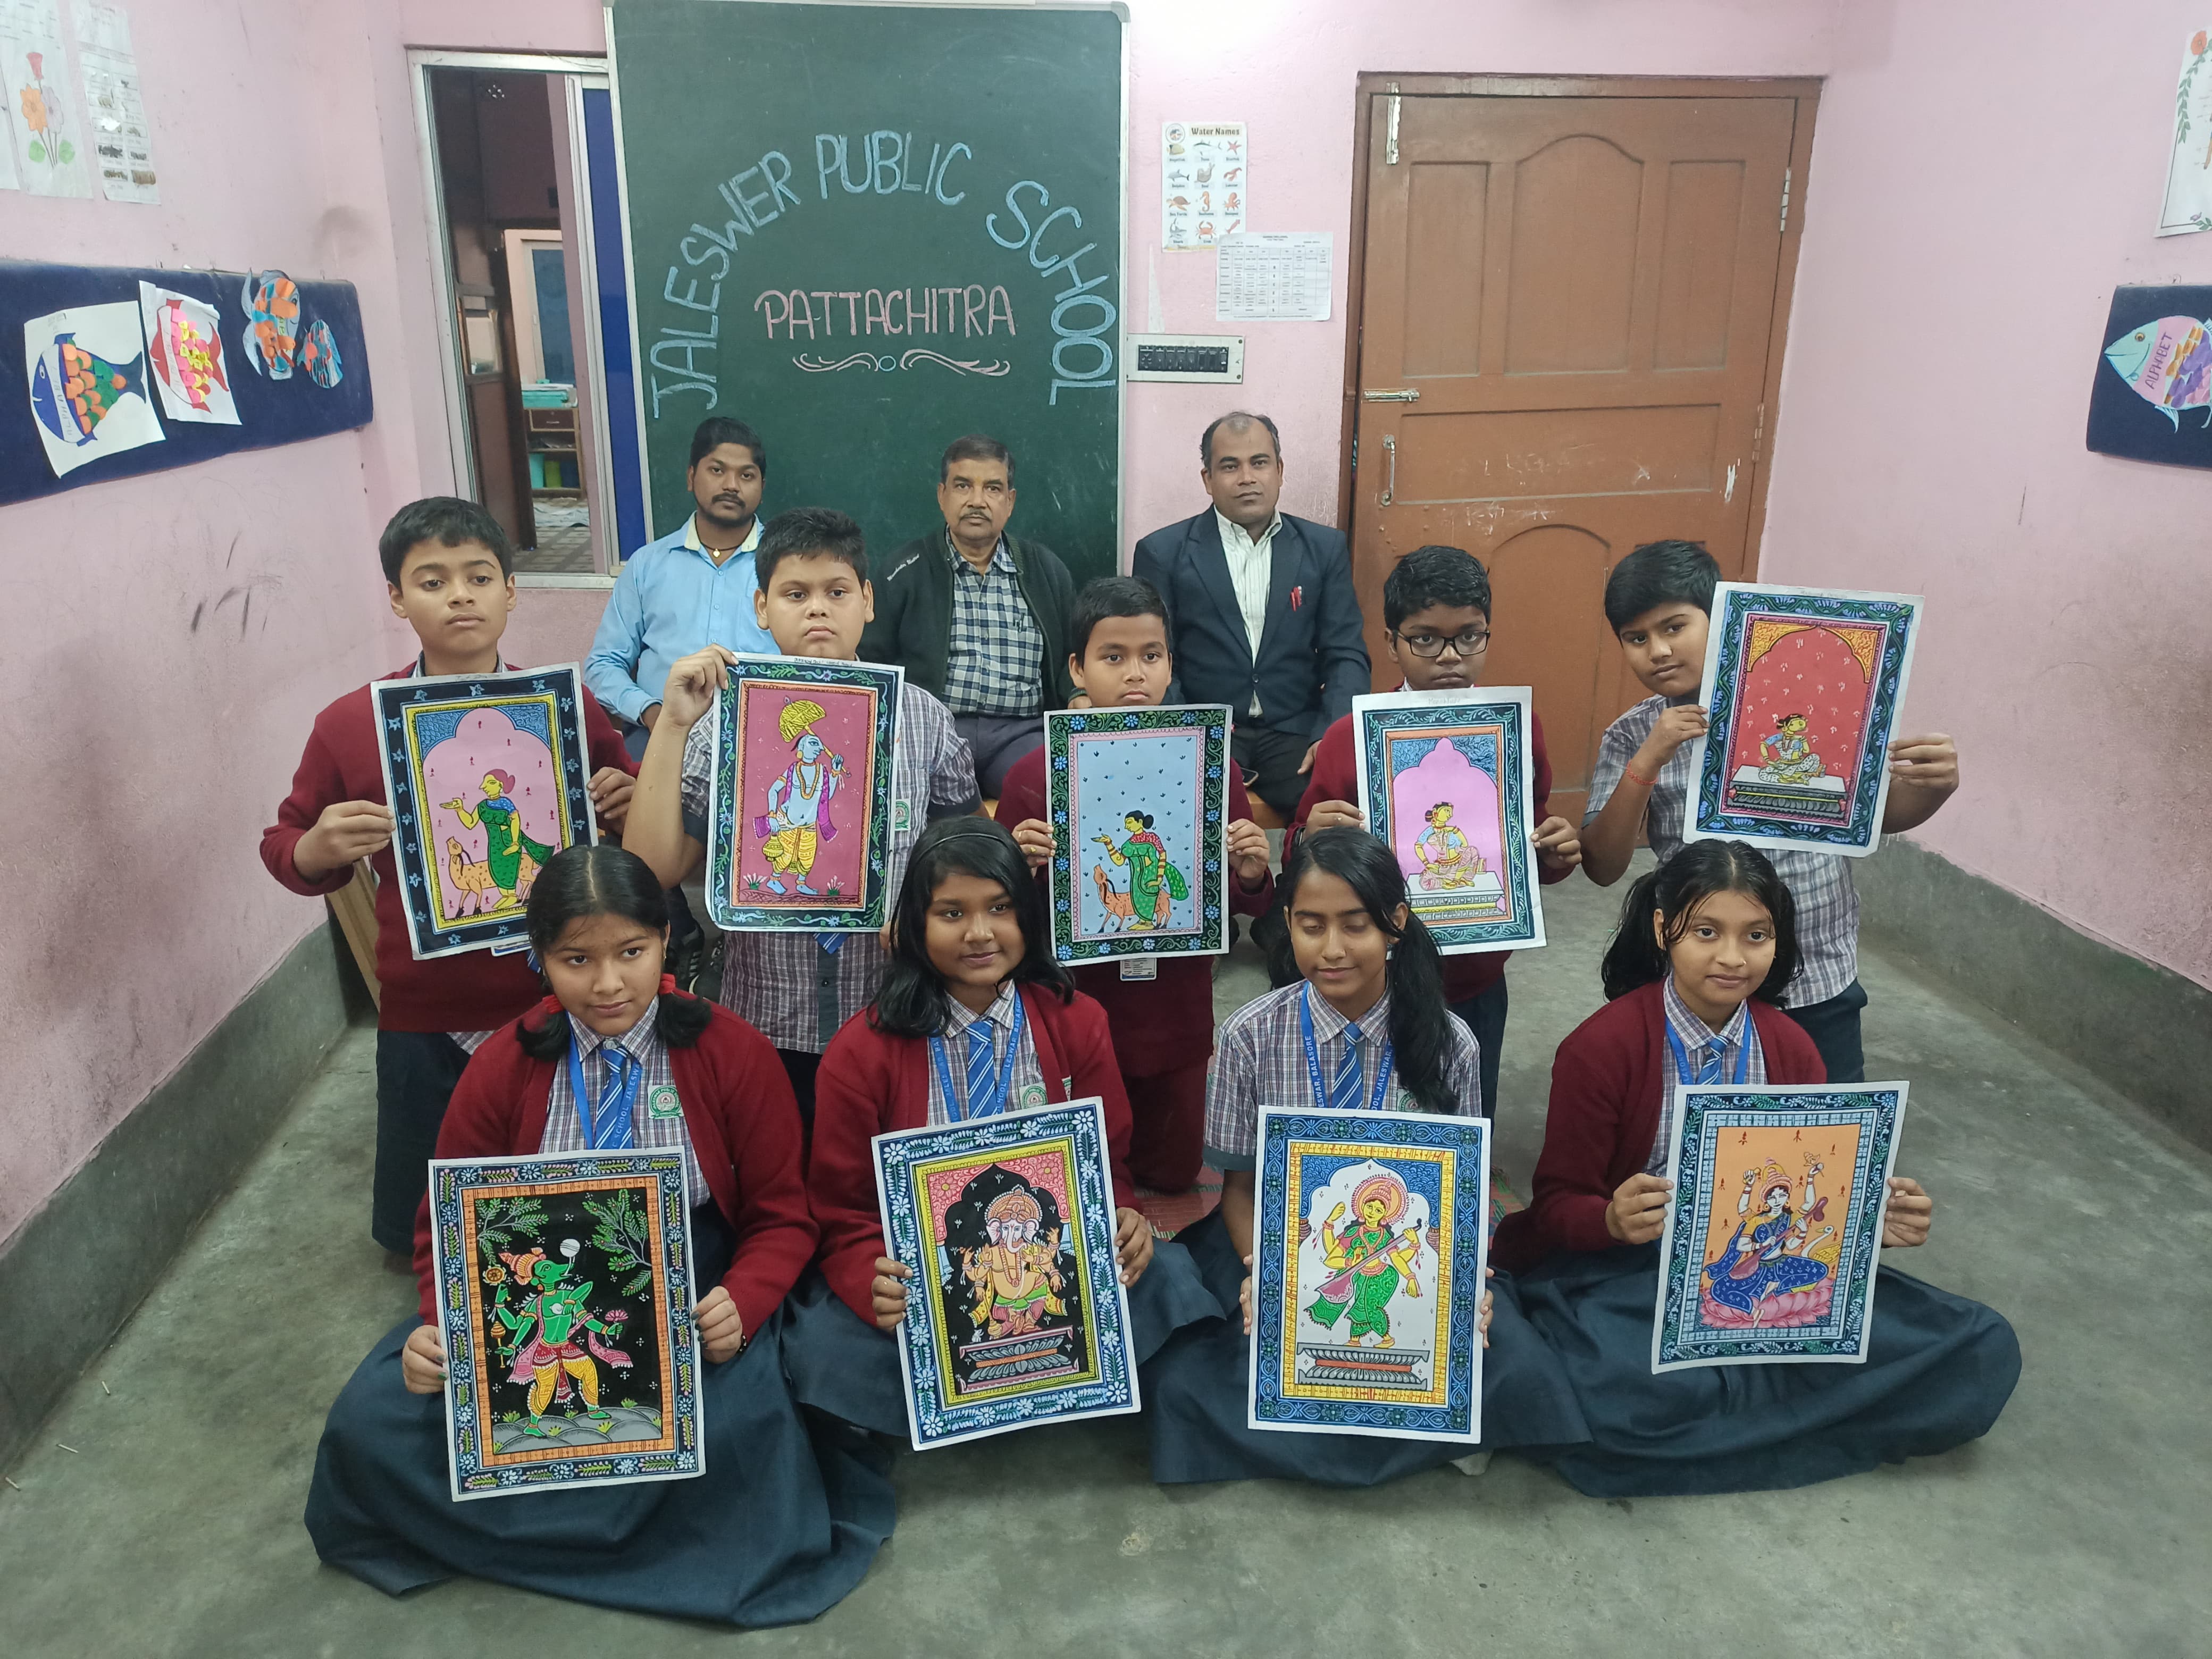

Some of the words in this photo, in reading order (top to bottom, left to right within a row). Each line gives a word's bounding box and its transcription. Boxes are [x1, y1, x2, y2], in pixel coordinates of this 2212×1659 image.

[649, 151, 800, 418] JALESWER
[815, 130, 972, 205] PUBLIC
[985, 180, 1117, 406] SCHOOL
[755, 284, 1016, 339] PATTACHITRA
[2145, 332, 2173, 390] ALPHABET
[1305, 1035, 1319, 1076] BALASORE
